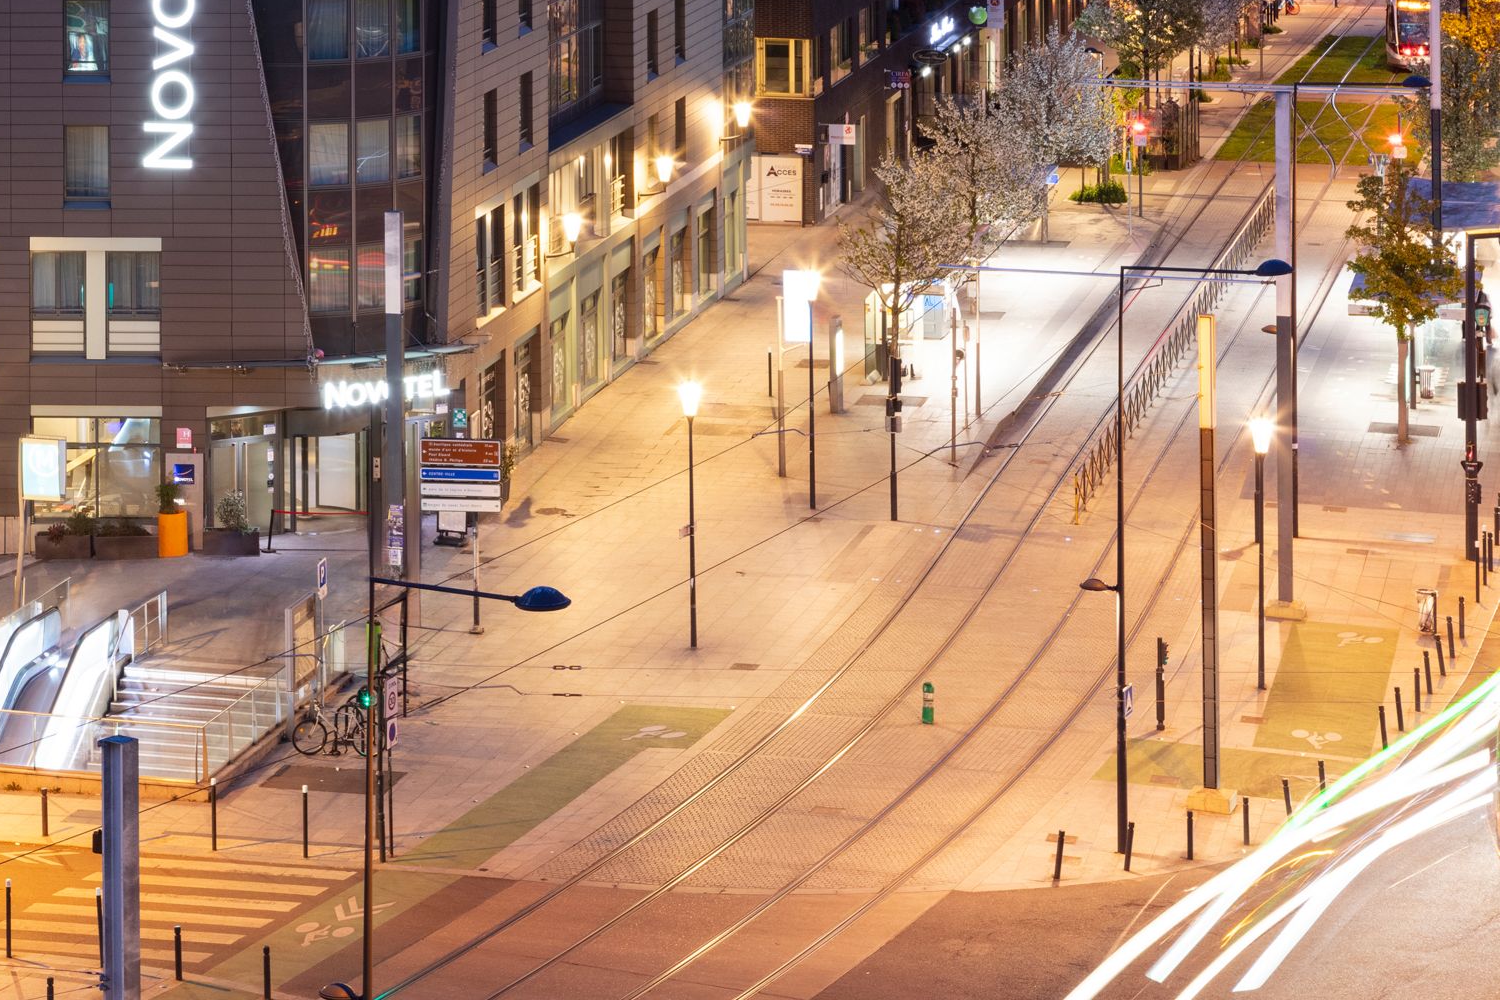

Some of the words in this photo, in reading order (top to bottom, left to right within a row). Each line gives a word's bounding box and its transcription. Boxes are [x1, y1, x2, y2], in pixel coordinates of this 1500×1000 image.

[766, 165, 797, 177] ACCES
[324, 369, 451, 410] NOVTEL
[320, 566, 325, 583] P
